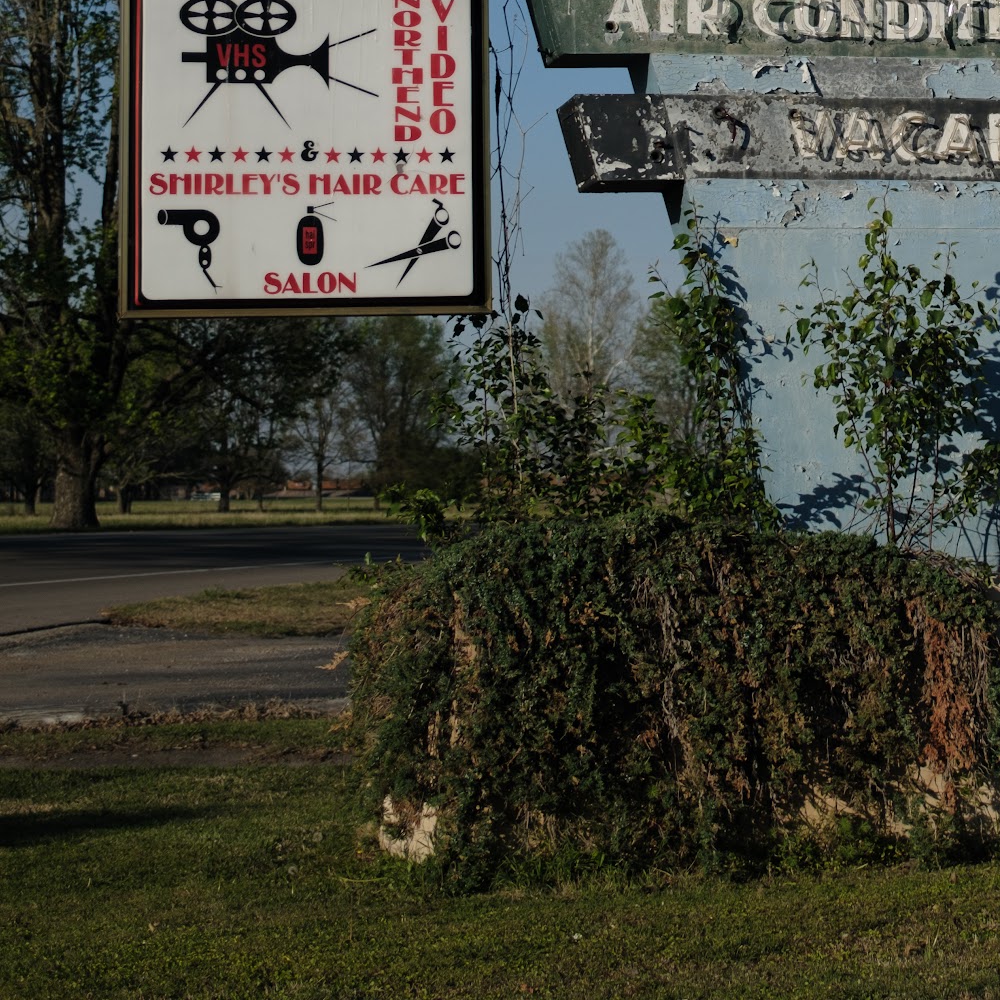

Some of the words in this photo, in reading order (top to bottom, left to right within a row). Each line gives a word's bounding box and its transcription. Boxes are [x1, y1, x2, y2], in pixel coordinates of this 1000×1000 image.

[217, 43, 267, 68] VHS
[301, 140, 319, 161] &
[149, 173, 300, 195] SHIRLEY'S
[309, 173, 381, 195] HAIR
[390, 173, 465, 195] CARE
[263, 272, 357, 294] SALON
